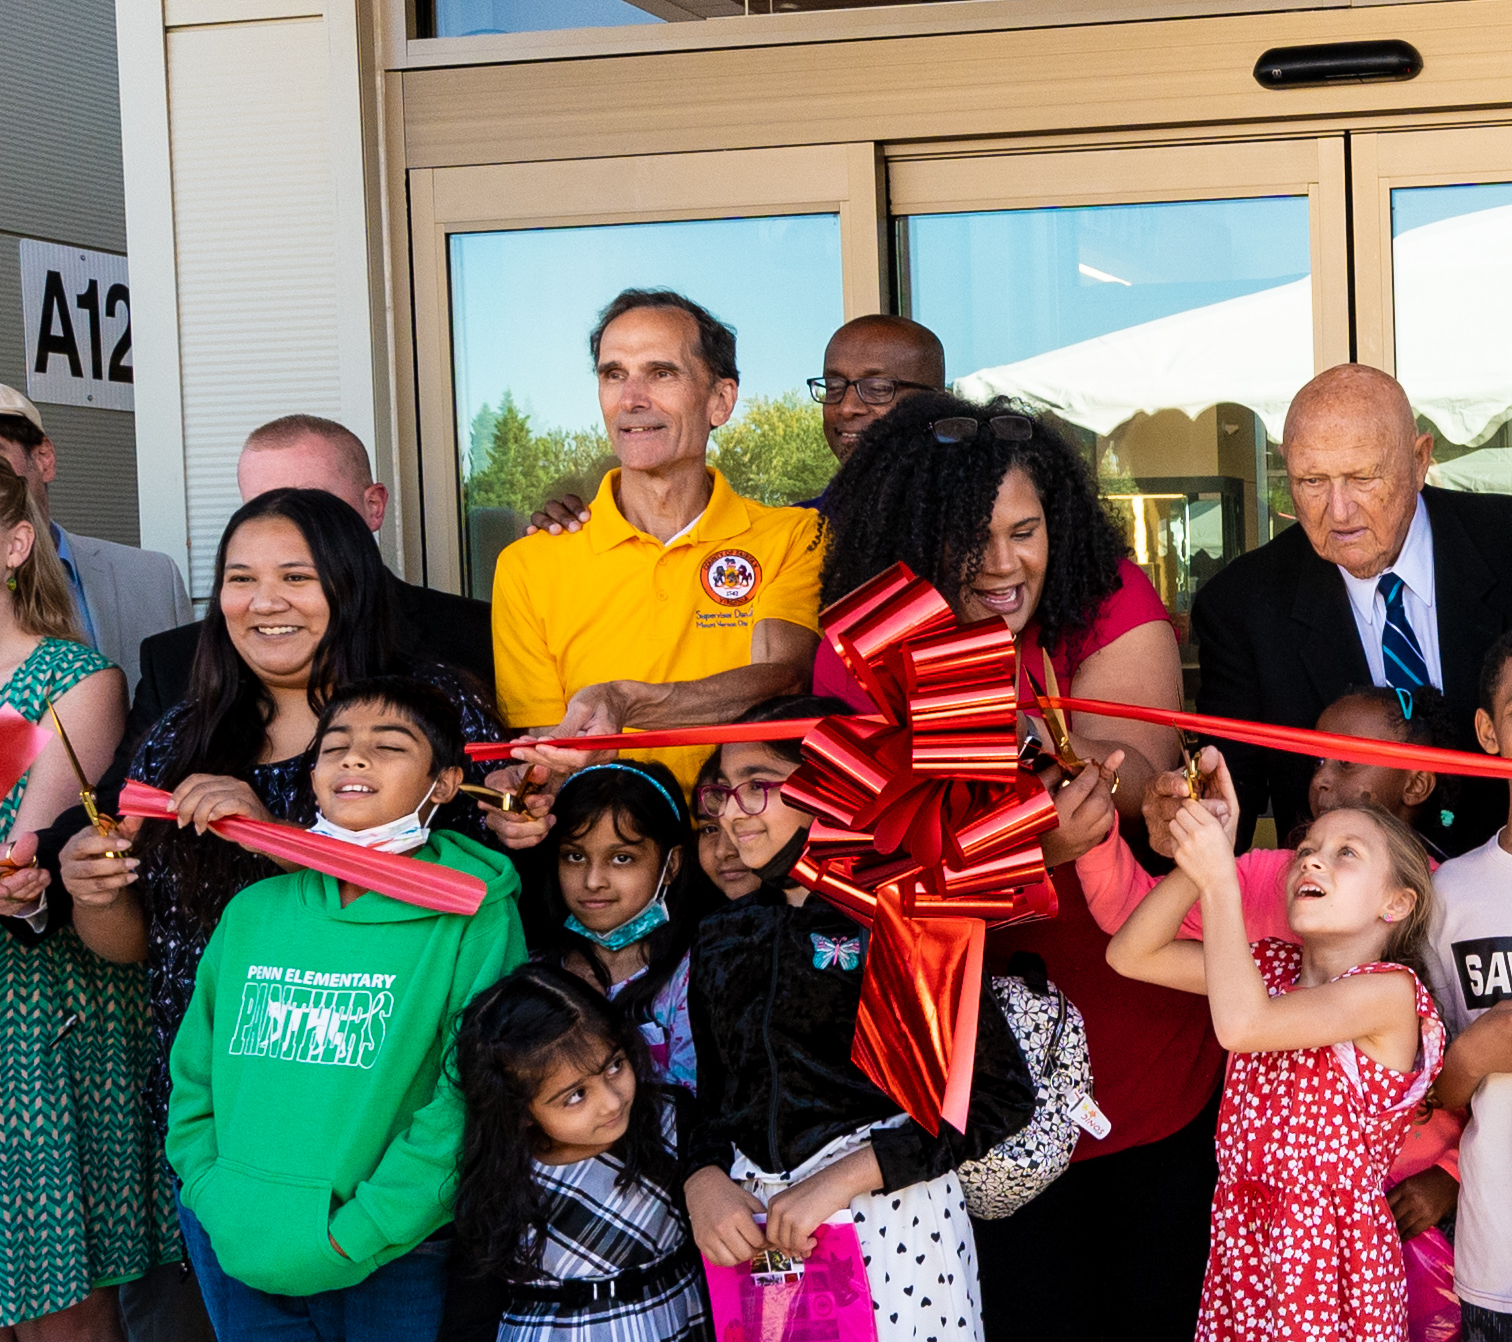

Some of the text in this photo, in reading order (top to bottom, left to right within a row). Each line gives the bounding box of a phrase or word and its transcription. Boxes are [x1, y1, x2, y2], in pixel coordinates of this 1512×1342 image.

[34, 269, 134, 384] A12
[247, 965, 397, 989] PENN ELEMENTARY
[228, 982, 395, 1069] PANTHERS
[1080, 1113, 1105, 1135] SONIC
